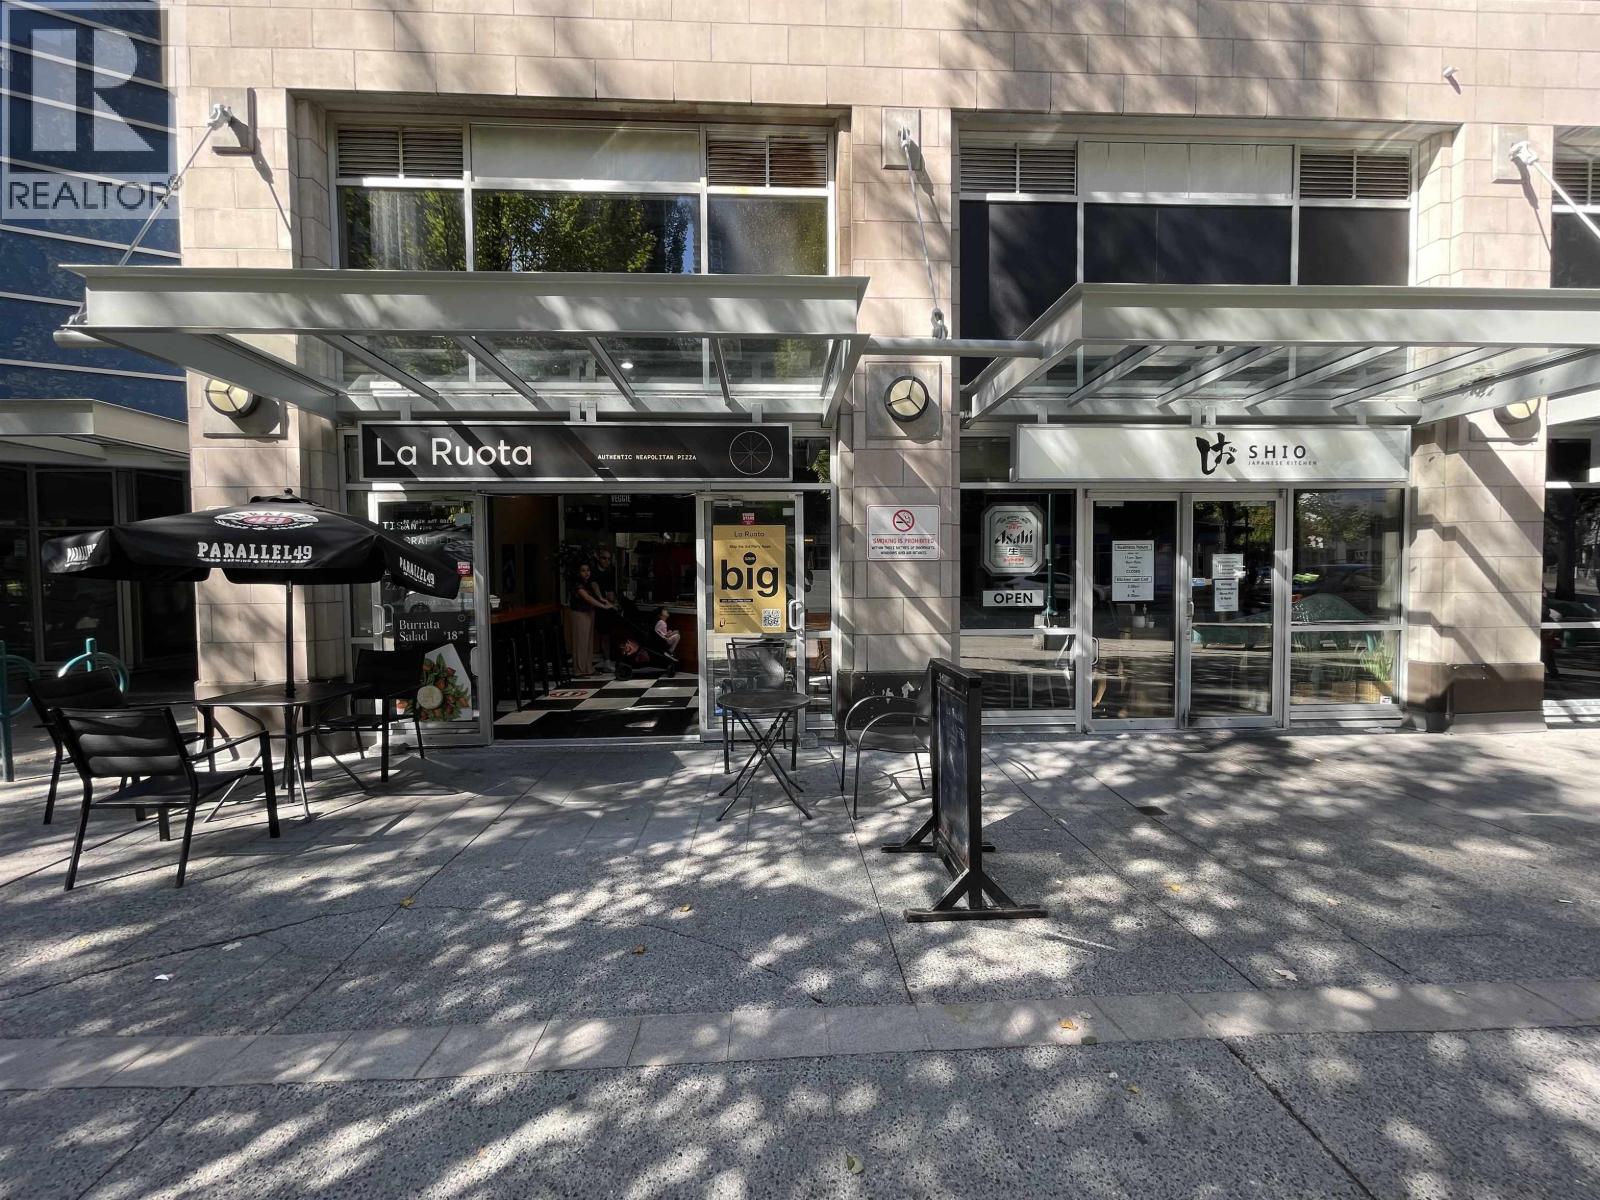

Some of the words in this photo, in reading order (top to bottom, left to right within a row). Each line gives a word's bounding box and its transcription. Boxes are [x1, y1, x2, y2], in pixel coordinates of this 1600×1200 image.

[376, 438, 417, 466] La
[431, 438, 532, 466] Ruota
[1248, 445, 1306, 459] SHIO
[994, 530, 1033, 545] Asahi
[197, 542, 313, 560] PARALLEL49
[1008, 548, 1019, 556] 生
[721, 559, 779, 597] big
[993, 592, 1033, 604] OPEN
[399, 620, 440, 630] Burrata
[399, 630, 428, 642] Salad
